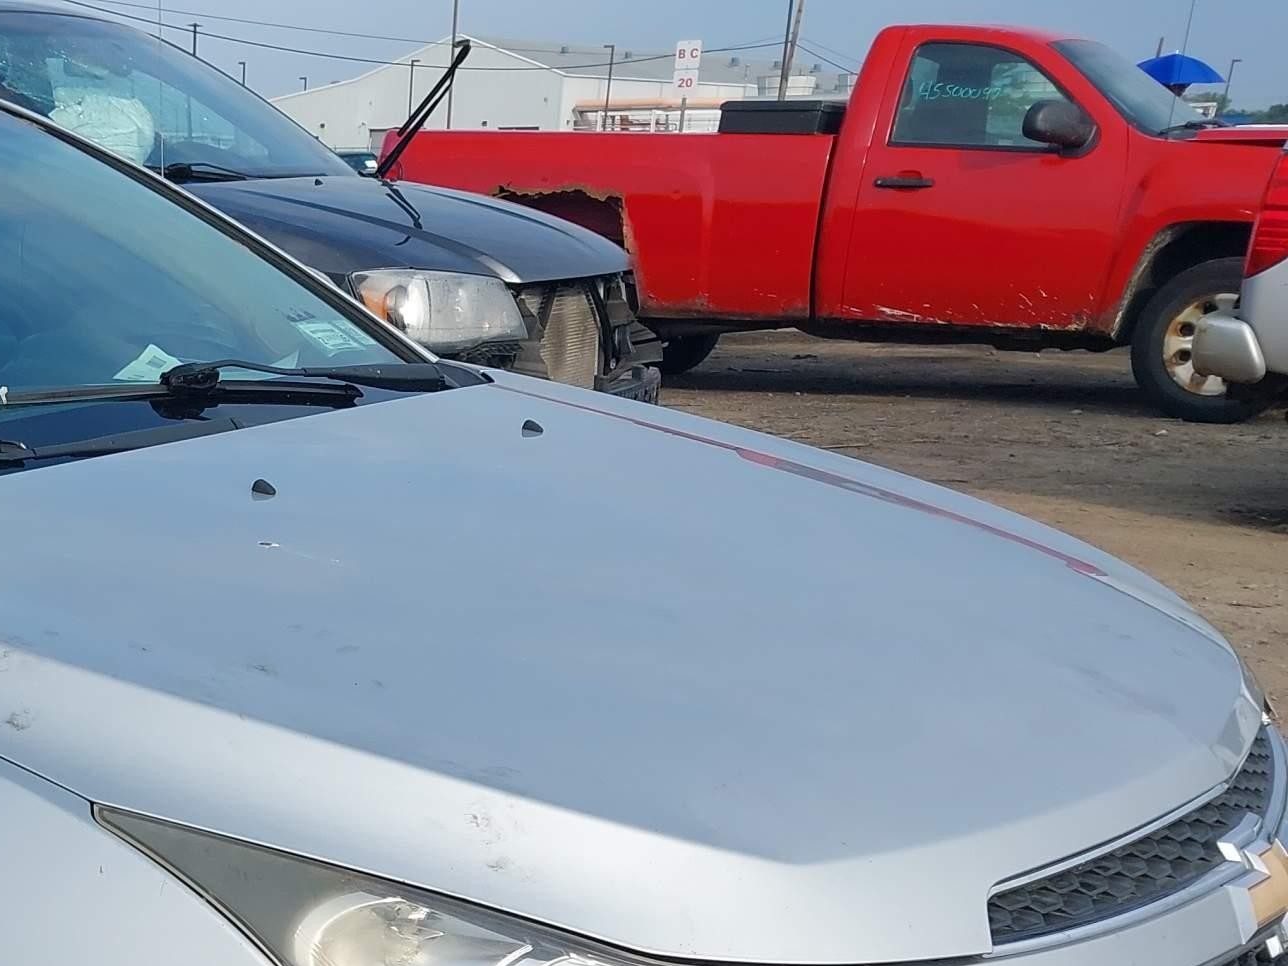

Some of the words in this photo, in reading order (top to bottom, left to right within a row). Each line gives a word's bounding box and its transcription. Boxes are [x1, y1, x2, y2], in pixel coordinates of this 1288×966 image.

[678, 48, 686, 59] B
[690, 48, 699, 58] C
[677, 78, 693, 88] 20
